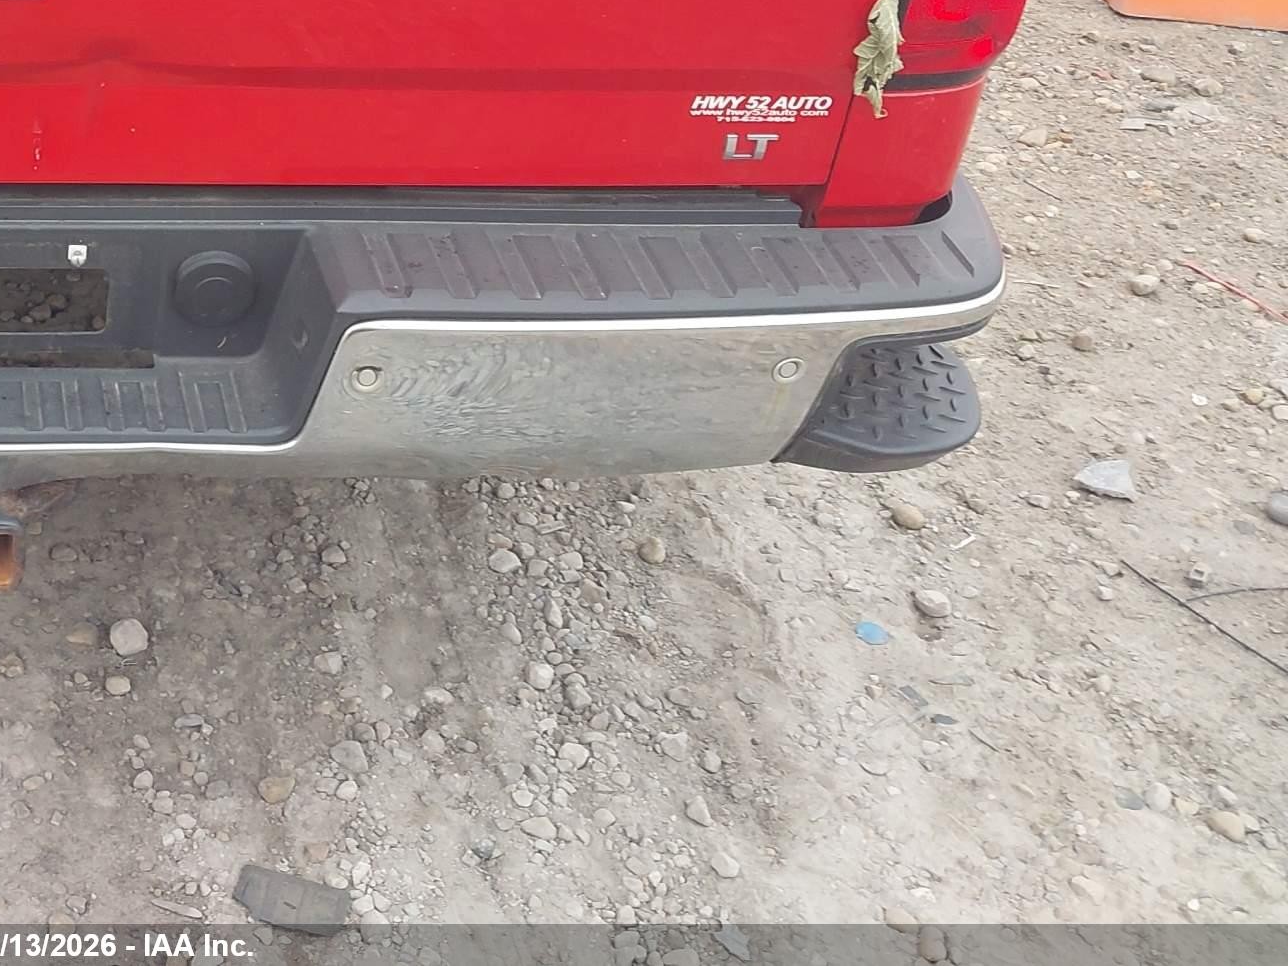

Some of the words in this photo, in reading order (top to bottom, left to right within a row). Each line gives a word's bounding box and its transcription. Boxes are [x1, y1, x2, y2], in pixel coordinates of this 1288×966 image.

[691, 95, 746, 109] HWY
[746, 95, 771, 109] 52
[773, 95, 833, 110] AUTO
[722, 133, 780, 160] LT
